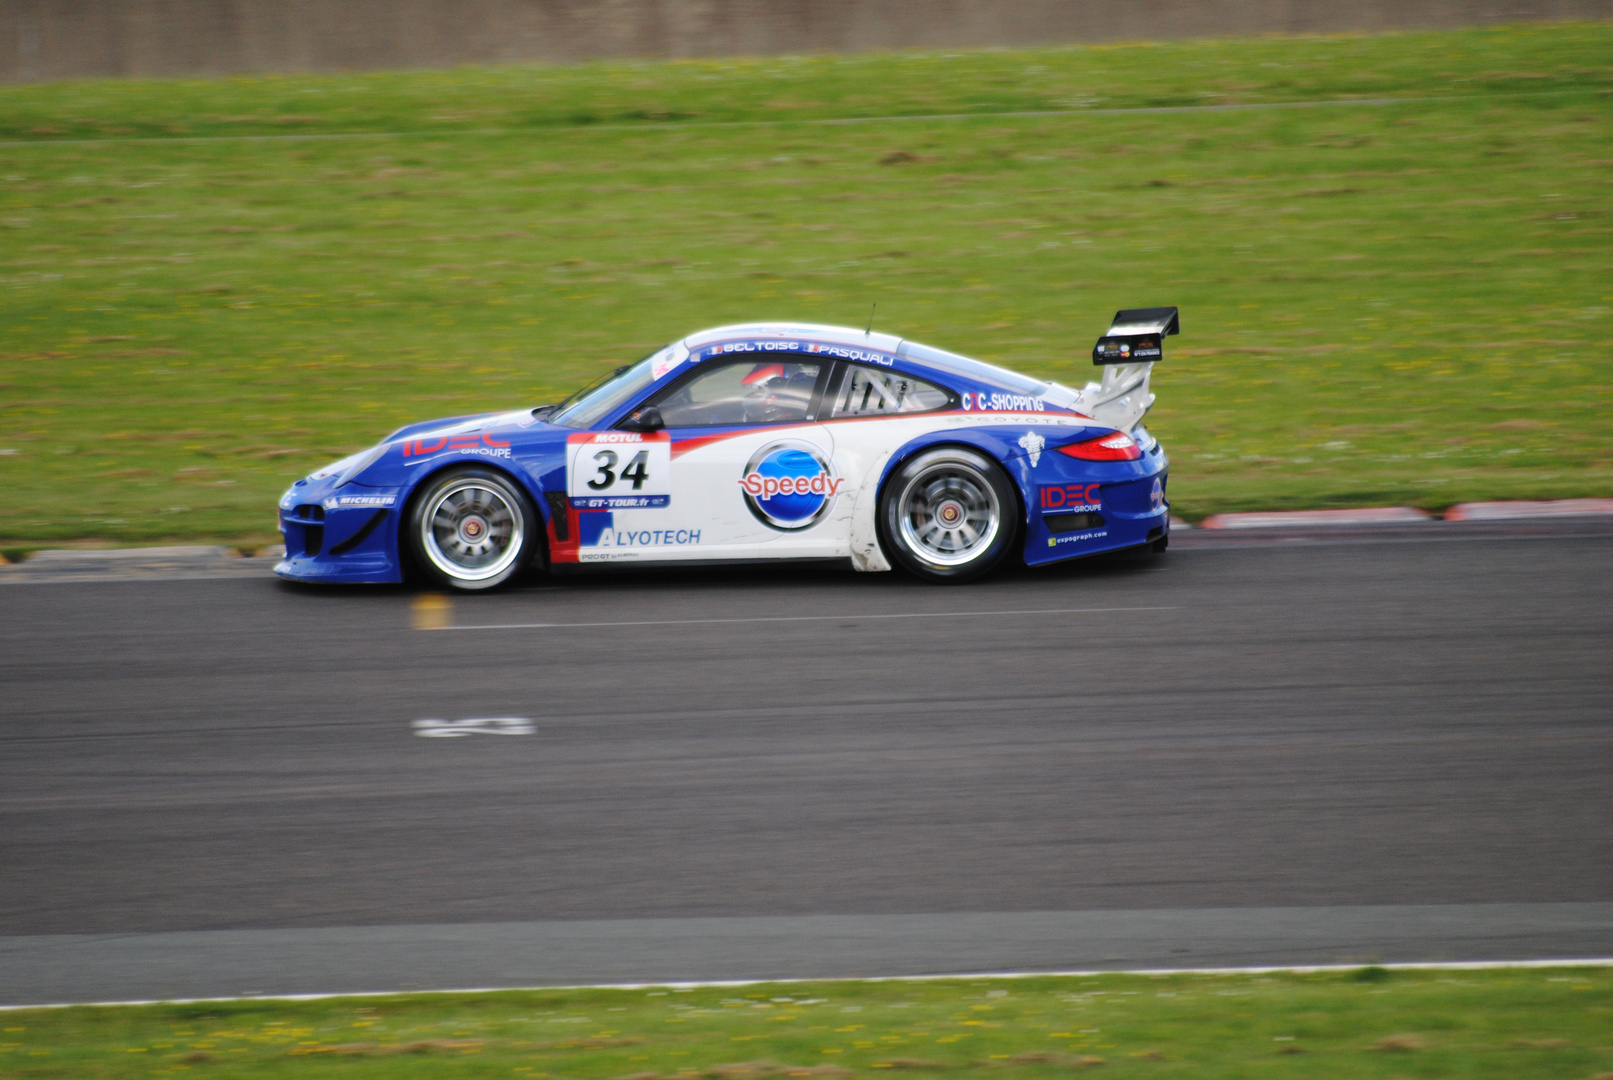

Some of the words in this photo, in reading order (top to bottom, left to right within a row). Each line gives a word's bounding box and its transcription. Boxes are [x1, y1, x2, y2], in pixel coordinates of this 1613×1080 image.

[723, 342, 799, 353] BELTOISE
[818, 345, 894, 367] PASQUALI
[977, 417, 1068, 426] COYOTE
[594, 432, 643, 443] MOTUL
[403, 432, 511, 457] IDEC
[461, 447, 512, 459] GROUPE
[587, 449, 650, 490] 34
[737, 472, 845, 500] Speedy
[340, 496, 395, 506] MICHELIN
[1040, 483, 1101, 508] IDEC
[588, 498, 649, 507] GT-TOUR.fr
[1074, 504, 1102, 513] GROUPE
[596, 528, 701, 547] ALYOTECH
[1056, 531, 1108, 544] expograph.com
